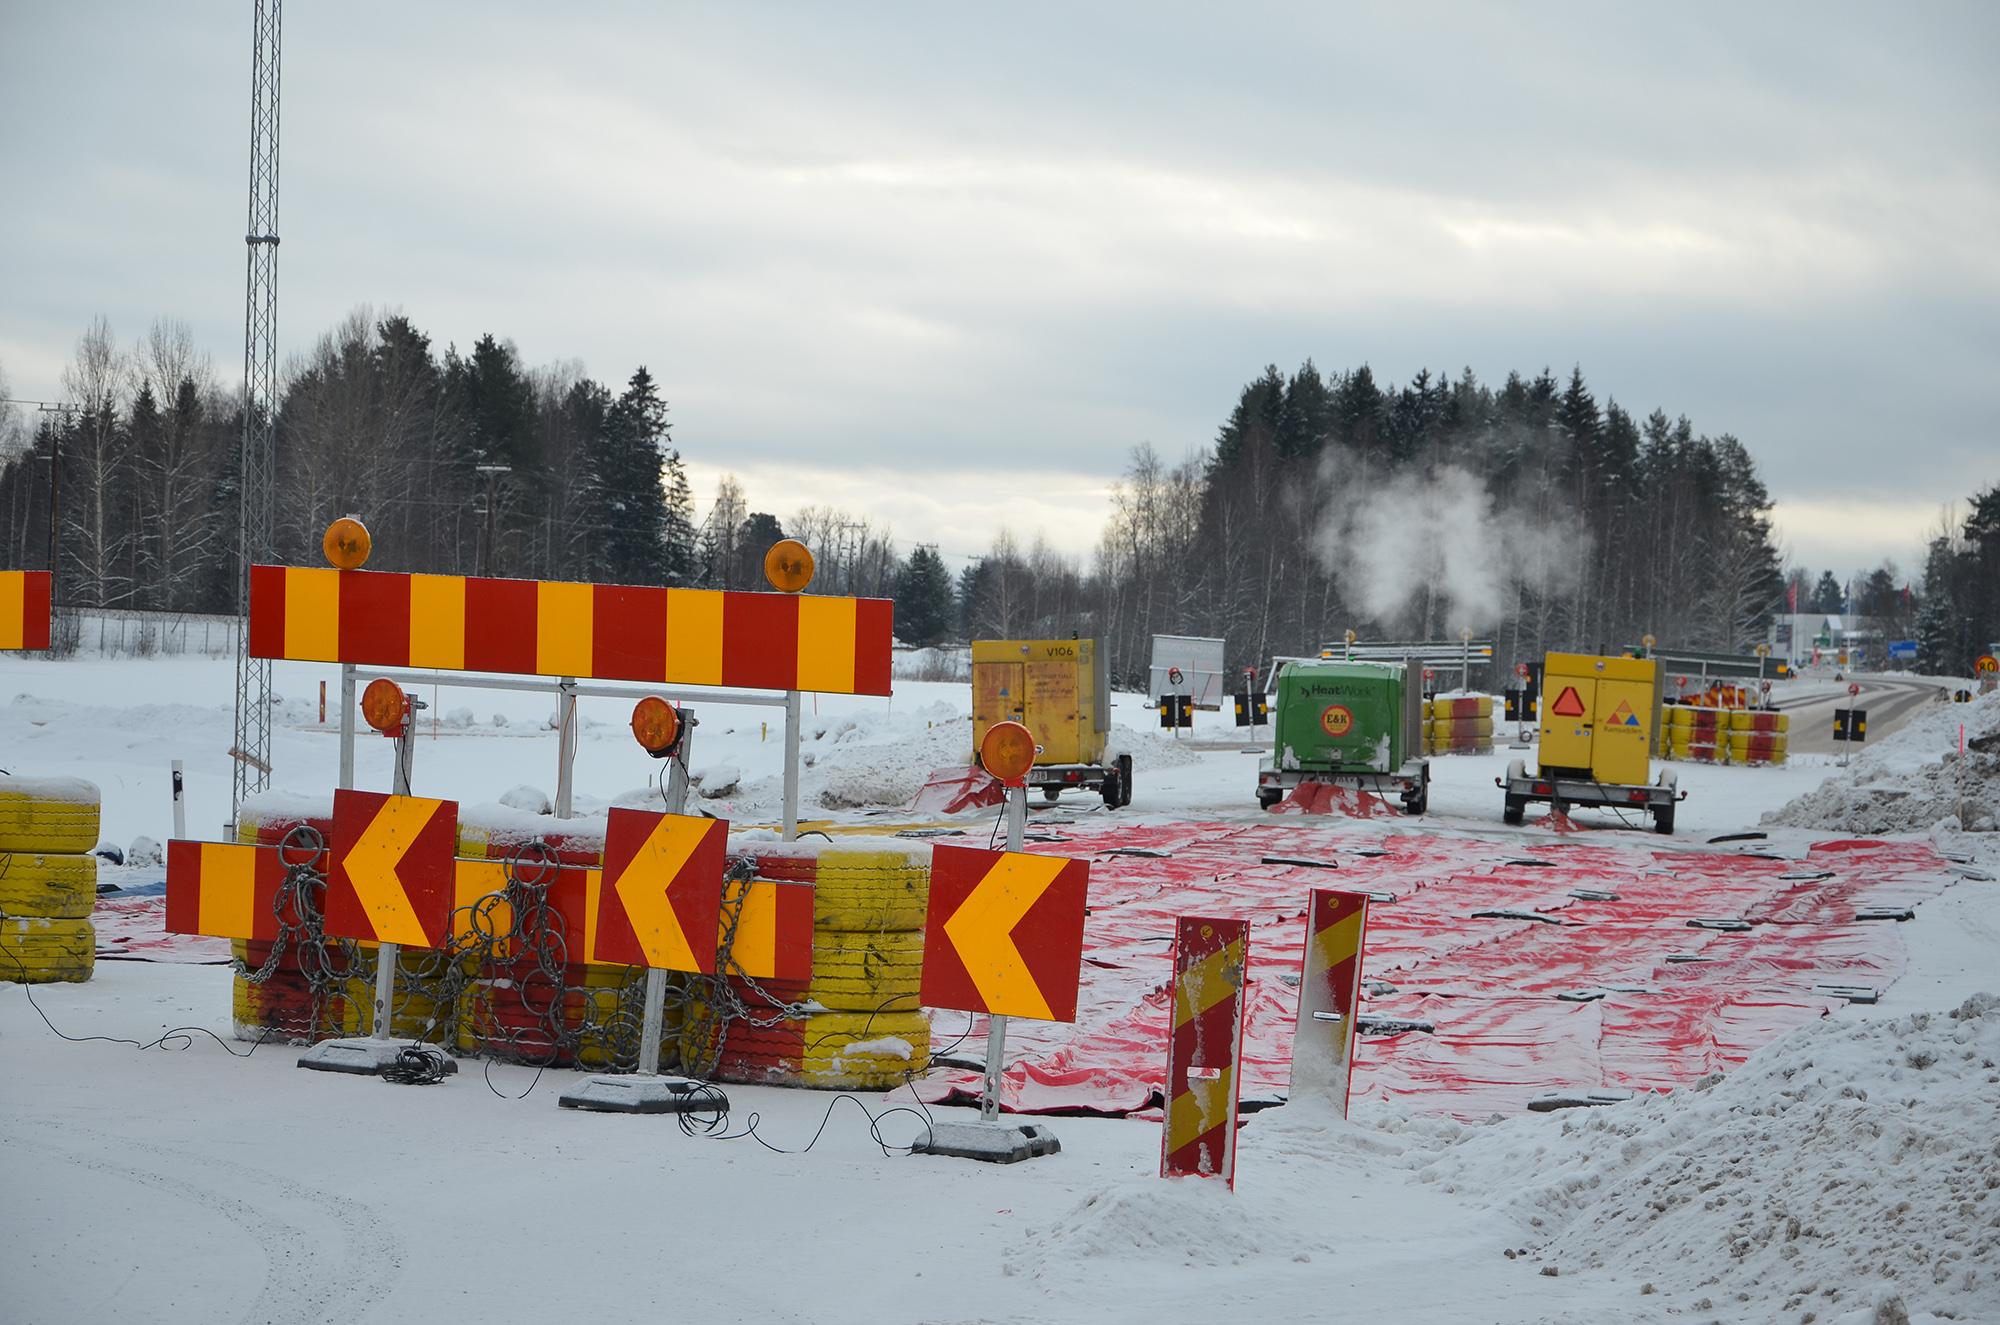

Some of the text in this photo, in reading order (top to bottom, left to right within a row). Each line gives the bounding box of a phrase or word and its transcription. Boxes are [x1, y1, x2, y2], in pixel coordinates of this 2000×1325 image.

[1047, 647, 1074, 656] V106
[1979, 661, 1995, 672] 80
[1311, 684, 1372, 696] HeatWork
[1326, 713, 1348, 724] E&K
[1604, 726, 1643, 735] Ramudden
